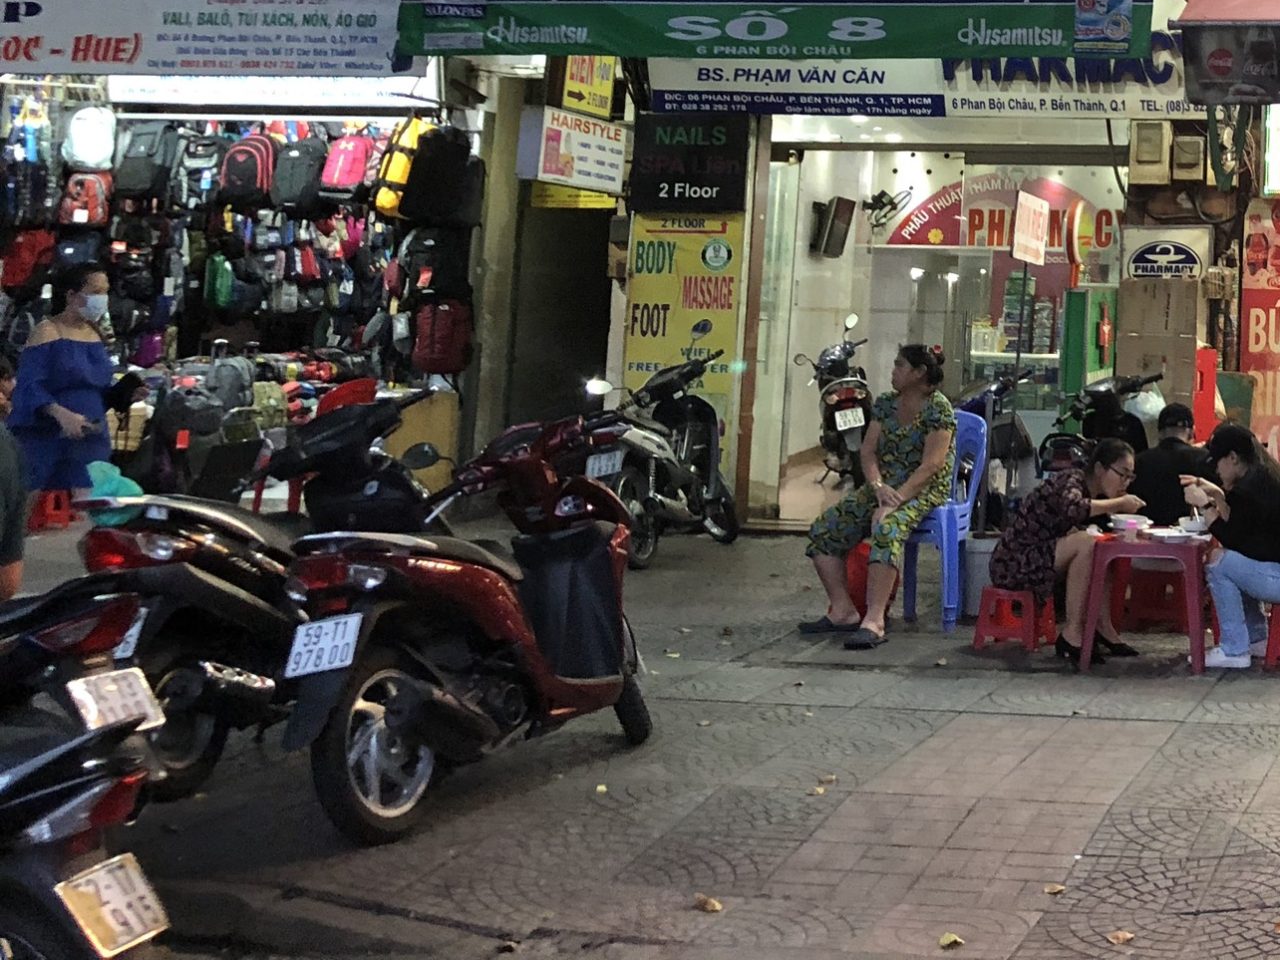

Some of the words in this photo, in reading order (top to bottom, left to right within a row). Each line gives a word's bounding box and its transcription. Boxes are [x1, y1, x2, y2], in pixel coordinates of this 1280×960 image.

[425, 6, 483, 17] SALONPAS
[487, 16, 589, 44] Hisamitsu
[664, 7, 802, 41] SỐ
[827, 16, 887, 41] 8
[957, 17, 1062, 47] Hisamitsu
[696, 46, 707, 55] 6
[713, 46, 759, 56] PHAN
[766, 44, 796, 57] BỘI
[803, 44, 851, 56] CHÂU
[697, 67, 729, 82] BS.
[733, 68, 790, 86] PHẠM
[798, 66, 836, 83] VĂN
[842, 67, 886, 84] CĂN
[701, 94, 730, 102] PHAN
[908, 97, 932, 105] HCM
[952, 98, 957, 109] 6
[961, 98, 985, 110] Phan
[989, 98, 1005, 113] Bội
[1008, 97, 1037, 112] Châu,
[1040, 99, 1047, 110] P.
[1051, 95, 1072, 111] Bến
[1074, 98, 1107, 114] Thành,
[1110, 99, 1125, 113] Q.1
[1140, 100, 1163, 112] TEL:
[551, 112, 622, 142] HAIRSTYLE
[655, 126, 727, 146] NAILS
[658, 182, 669, 198] 2
[674, 182, 720, 199] Floor
[661, 219, 668, 228] 2
[671, 218, 705, 228] FLOOR
[901, 206, 930, 240] PHẪU
[931, 187, 965, 214] THUẬT
[635, 240, 676, 274] BODY
[1134, 264, 1195, 274] PHARMACY
[682, 276, 734, 310] MASSAGE
[631, 303, 670, 337] FOOT
[628, 362, 661, 372] FREE
[303, 620, 348, 647] 59-T1
